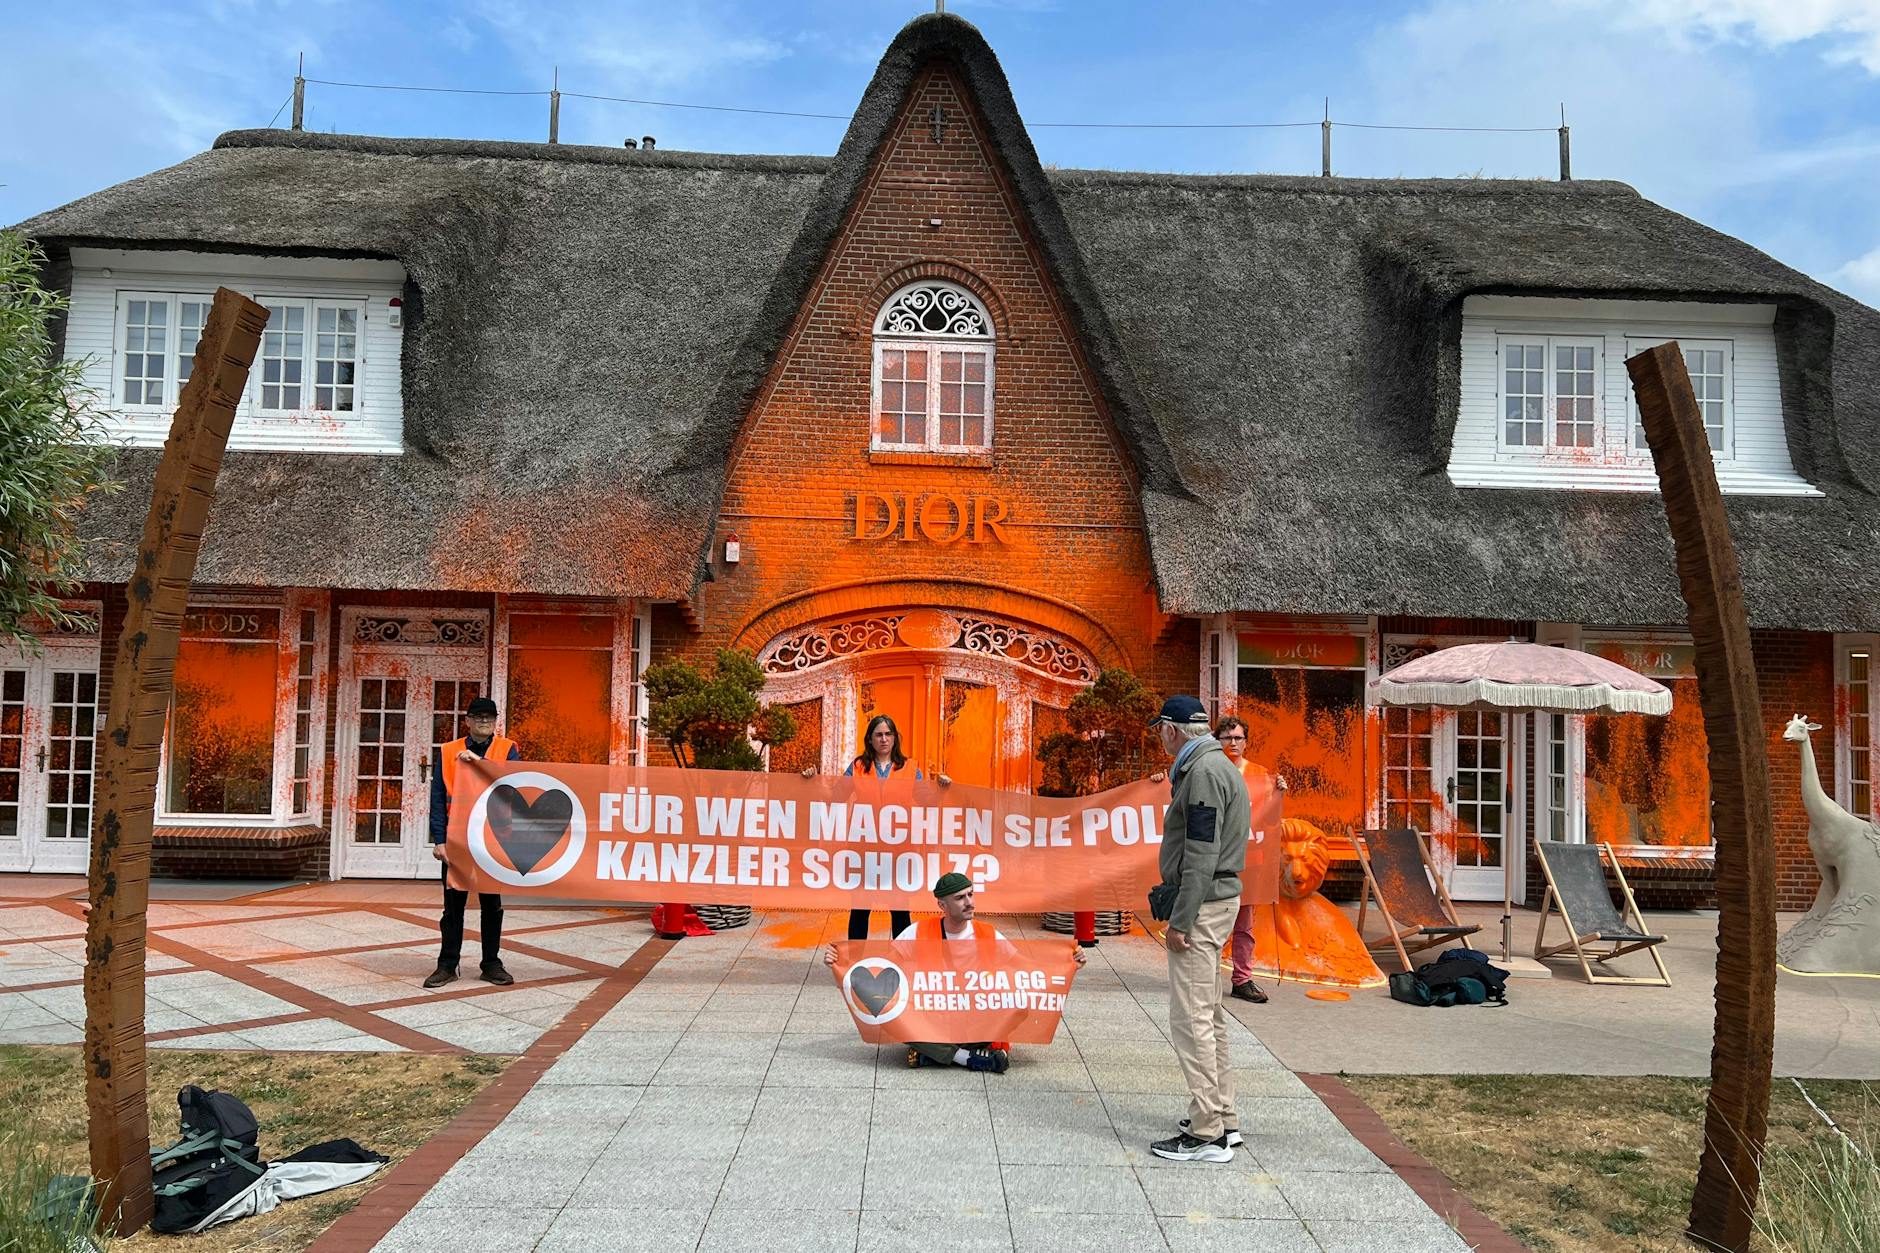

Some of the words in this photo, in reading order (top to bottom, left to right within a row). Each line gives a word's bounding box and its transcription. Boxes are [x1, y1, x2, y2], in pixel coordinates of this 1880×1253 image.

[850, 493, 1012, 545] DIOR
[195, 614, 259, 633] TOD'S
[599, 786, 684, 835] FÜR
[695, 796, 796, 840] WEN
[809, 801, 993, 846] MACHEN
[1004, 814, 1072, 847] SIE
[596, 840, 790, 887] KANZLER
[912, 970, 960, 991] ART.
[965, 970, 1011, 990] 20A
[1014, 970, 1047, 990] GG
[914, 993, 971, 1011] LEBEN
[975, 989, 1067, 1012] SCHÜTZEN
